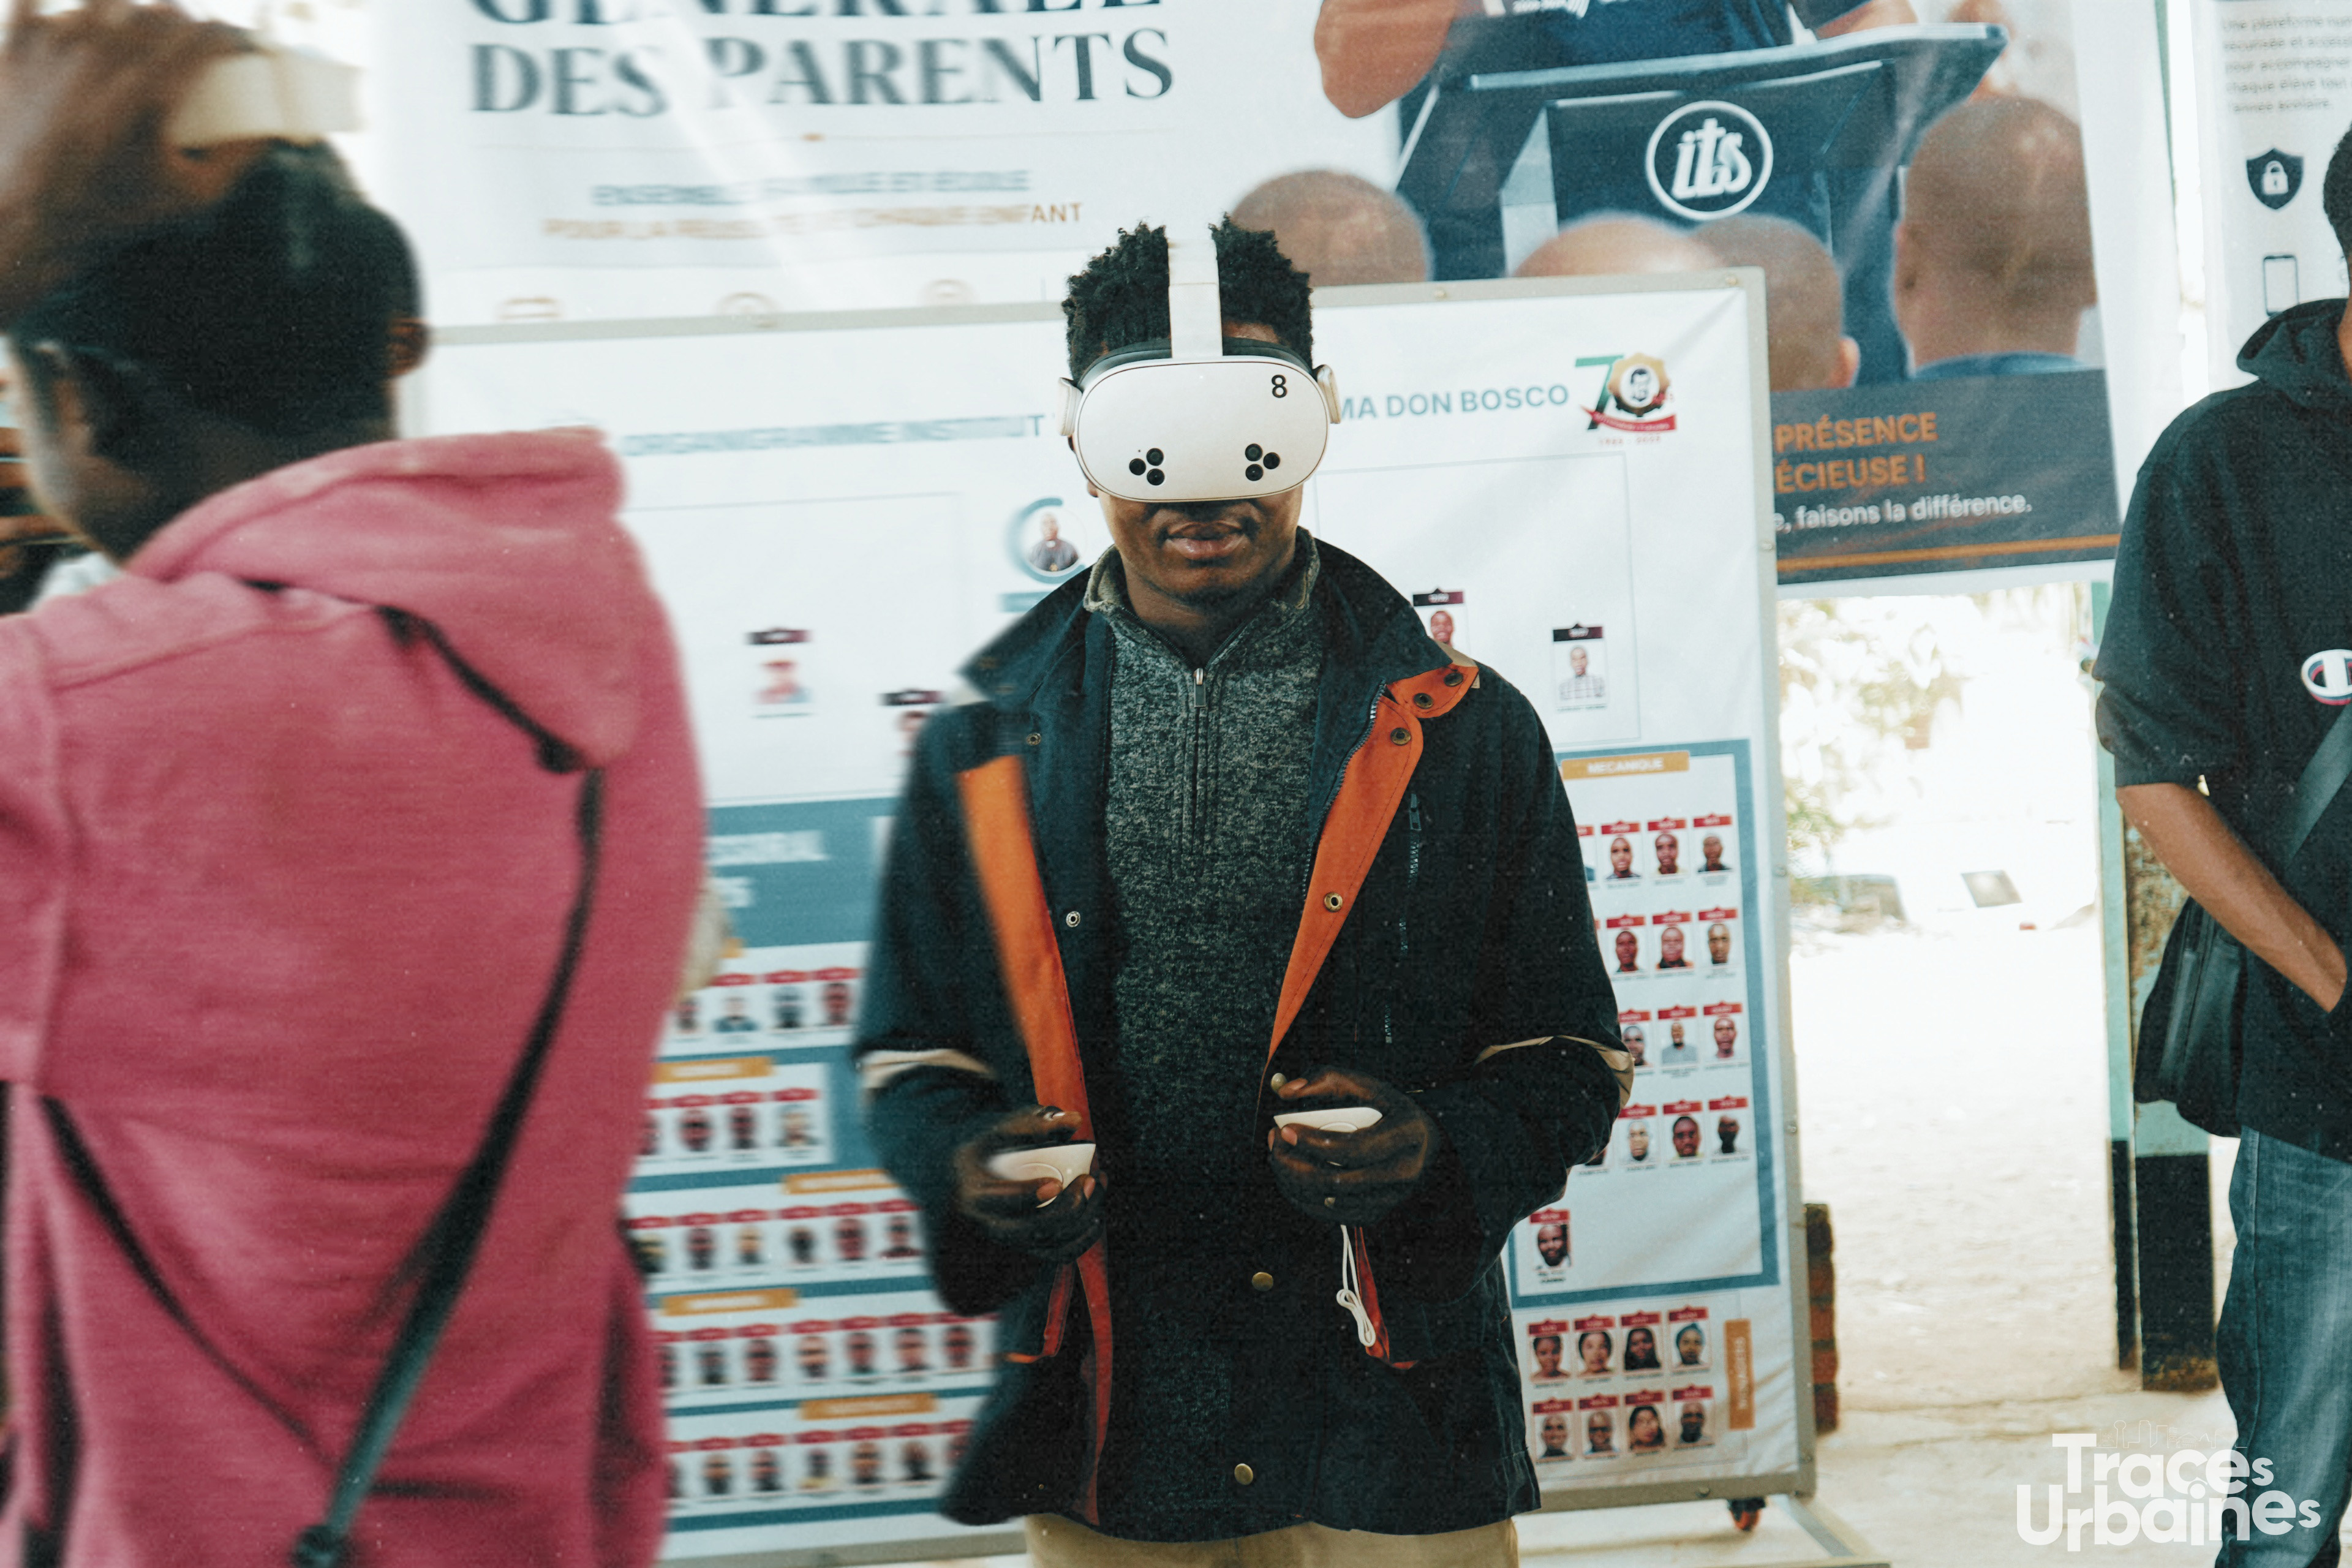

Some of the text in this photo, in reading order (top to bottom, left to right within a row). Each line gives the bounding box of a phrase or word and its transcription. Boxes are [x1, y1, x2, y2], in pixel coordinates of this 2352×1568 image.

[469, 28, 1172, 117] DES PARENTS
[1271, 374, 1287, 398] 8
[1341, 383, 1569, 420] MA DON BOSCO
[1774, 412, 1939, 453] PRÉSENCE
[1774, 454, 1909, 494] ÉCIEUSE
[1795, 503, 1880, 530] faisons
[1883, 499, 1906, 522] la
[1912, 492, 2032, 520] différence.
